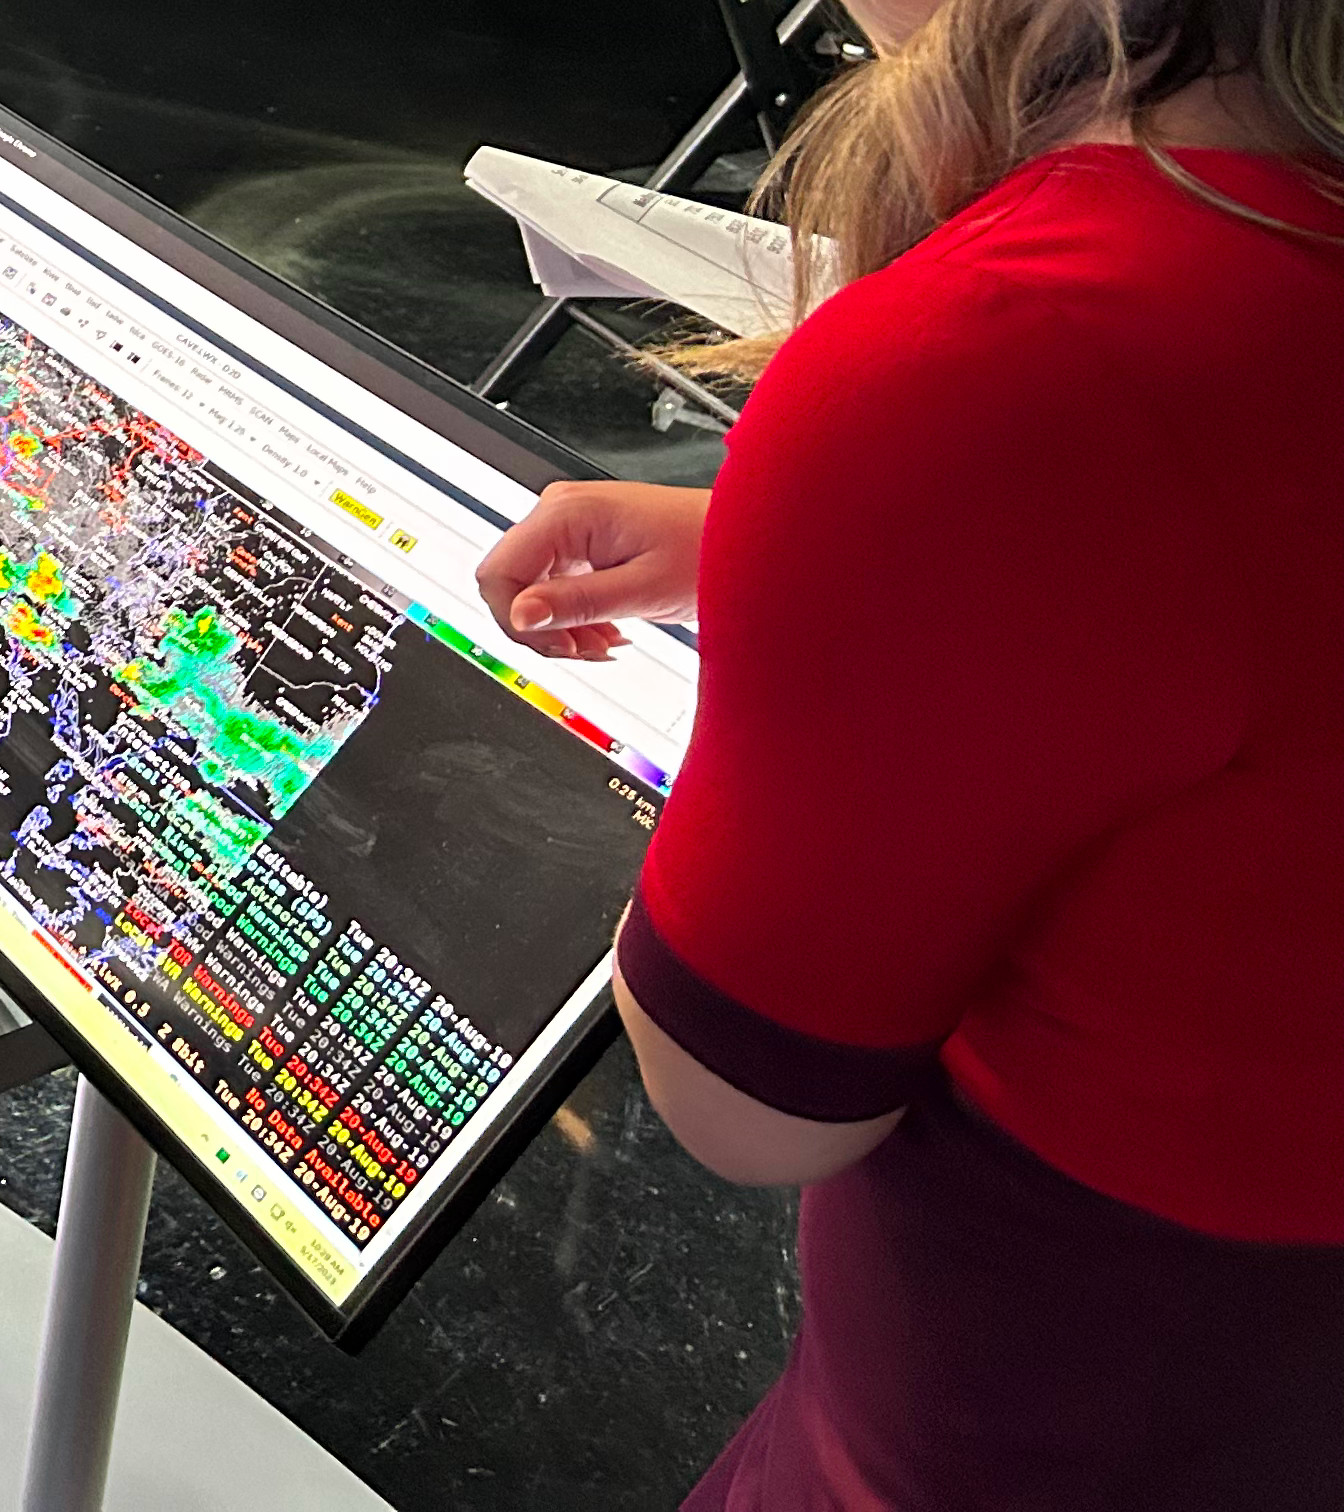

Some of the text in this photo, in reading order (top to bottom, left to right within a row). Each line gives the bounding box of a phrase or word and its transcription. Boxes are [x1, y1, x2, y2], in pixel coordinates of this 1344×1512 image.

[332, 490, 378, 528] WarnGen
[329, 611, 354, 634] Kent
[112, 911, 156, 953] Local
[152, 951, 184, 982] SVR
[176, 976, 248, 1044] Warnings
[243, 1038, 278, 1072] Tue
[272, 1065, 332, 1122] 20:34Z
[322, 1119, 410, 1201] 20-Aug-19
[118, 786, 163, 830] Local
[242, 900, 312, 966] Warnings
[310, 959, 344, 991] Tue
[340, 985, 399, 1040] 20:34Z
[393, 1035, 479, 1116] 20-Aug-19
[123, 899, 166, 941] Local
[164, 938, 195, 968] TOR
[187, 963, 259, 1032] Warnings
[254, 1024, 289, 1058] Tue
[283, 1052, 343, 1108] 20:34Z
[334, 1105, 420, 1187] 20-Aug-19
[210, 938, 280, 1004] Warnings
[277, 999, 310, 1030] Tue
[307, 1026, 364, 1080] 20:34Z
[359, 1078, 443, 1157] 20-Aug-19
[220, 925, 455, 1144] Warnings Tue 20:34Z 20-Aug-19
[231, 911, 302, 979] Warnings
[300, 972, 332, 1004] Tue
[329, 998, 387, 1053] 20:34Z
[381, 1049, 467, 1130] 20-Aug-19
[239, 872, 324, 952] Advisories
[321, 945, 355, 978] Tue
[352, 972, 409, 1026] 20:34Z
[404, 1021, 490, 1101] 20-Aug-19
[288, 893, 335, 938] (SPS)
[332, 932, 366, 965] Tue
[363, 958, 421, 1013] 20:34Z
[416, 1006, 503, 1088] 20-Aug-19
[343, 919, 378, 952] Tue
[374, 945, 432, 1000] 20:34Z
[429, 991, 515, 1073] 20-Aug-19
[120, 987, 154, 1020] 0.5
[154, 1021, 174, 1041] Z
[210, 1078, 245, 1112] Tue
[236, 1107, 297, 1165] 20:34Z
[287, 1160, 376, 1244] 20-Aug-19
[167, 989, 237, 1055] Warnings
[233, 1052, 266, 1084] Tue
[261, 1081, 318, 1135] 20:34Z
[312, 1133, 398, 1214] 20-Aug-19
[198, 951, 269, 1018] Warnings
[266, 1012, 299, 1044] Tue
[296, 1039, 354, 1094] 20:34Z
[346, 1092, 432, 1172] 20-Aug-19
[242, 1086, 387, 1229] No Data Available
